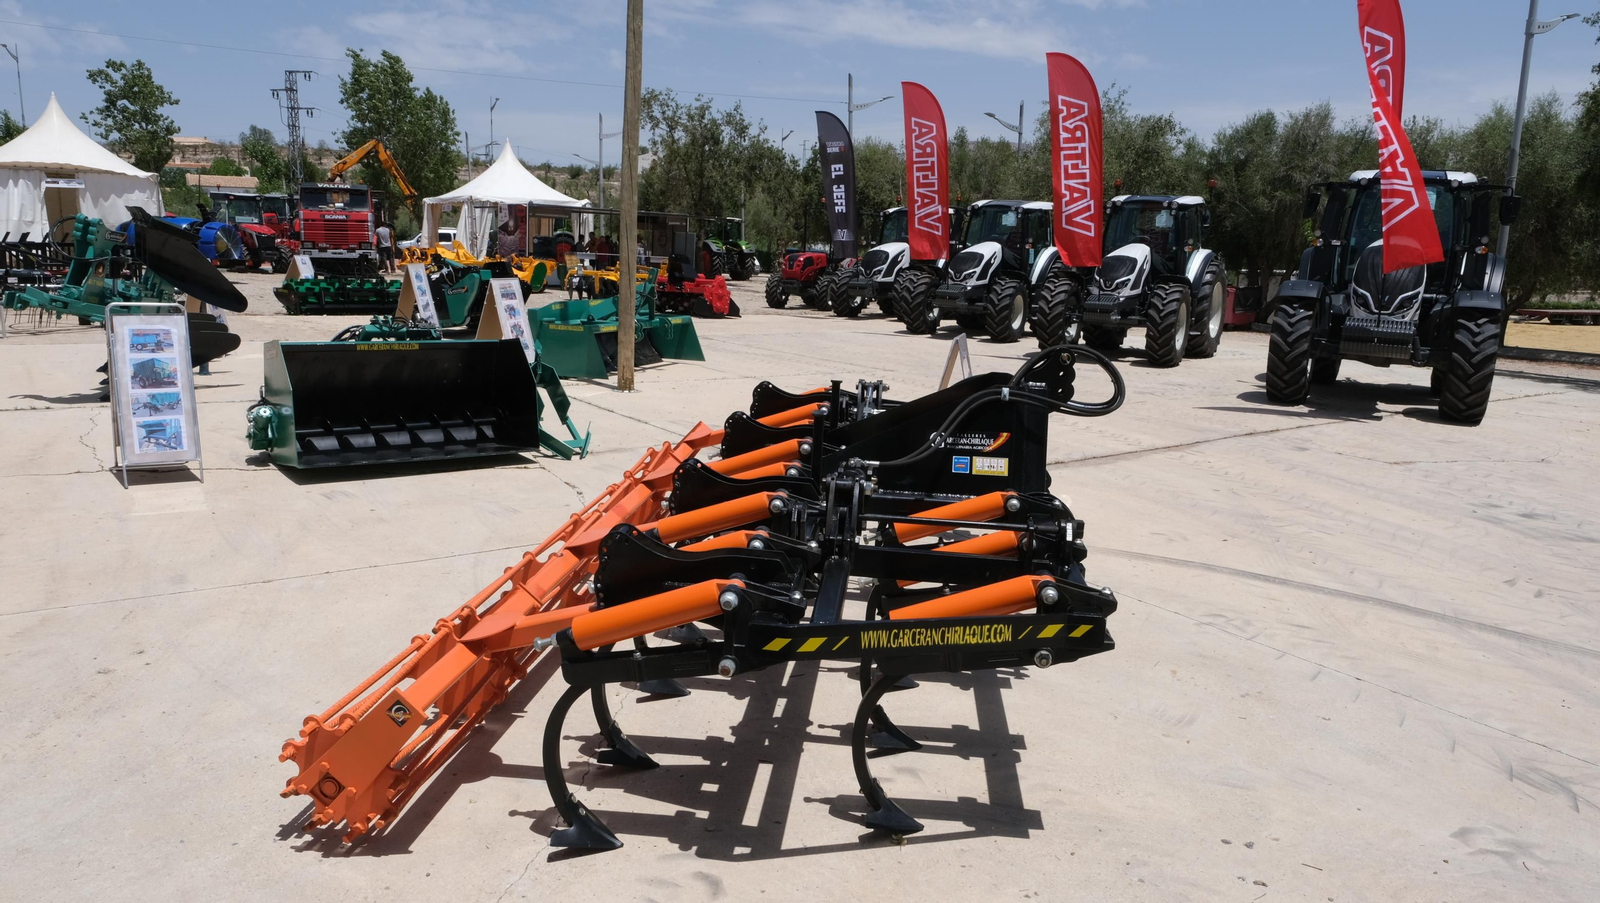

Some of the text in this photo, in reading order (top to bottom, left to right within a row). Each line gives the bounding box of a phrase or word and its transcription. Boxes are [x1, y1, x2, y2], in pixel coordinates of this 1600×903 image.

[831, 164, 846, 213] EL JEFE
[860, 625, 1013, 650] WWW.GARCERANCHIRLAQUE.COM
